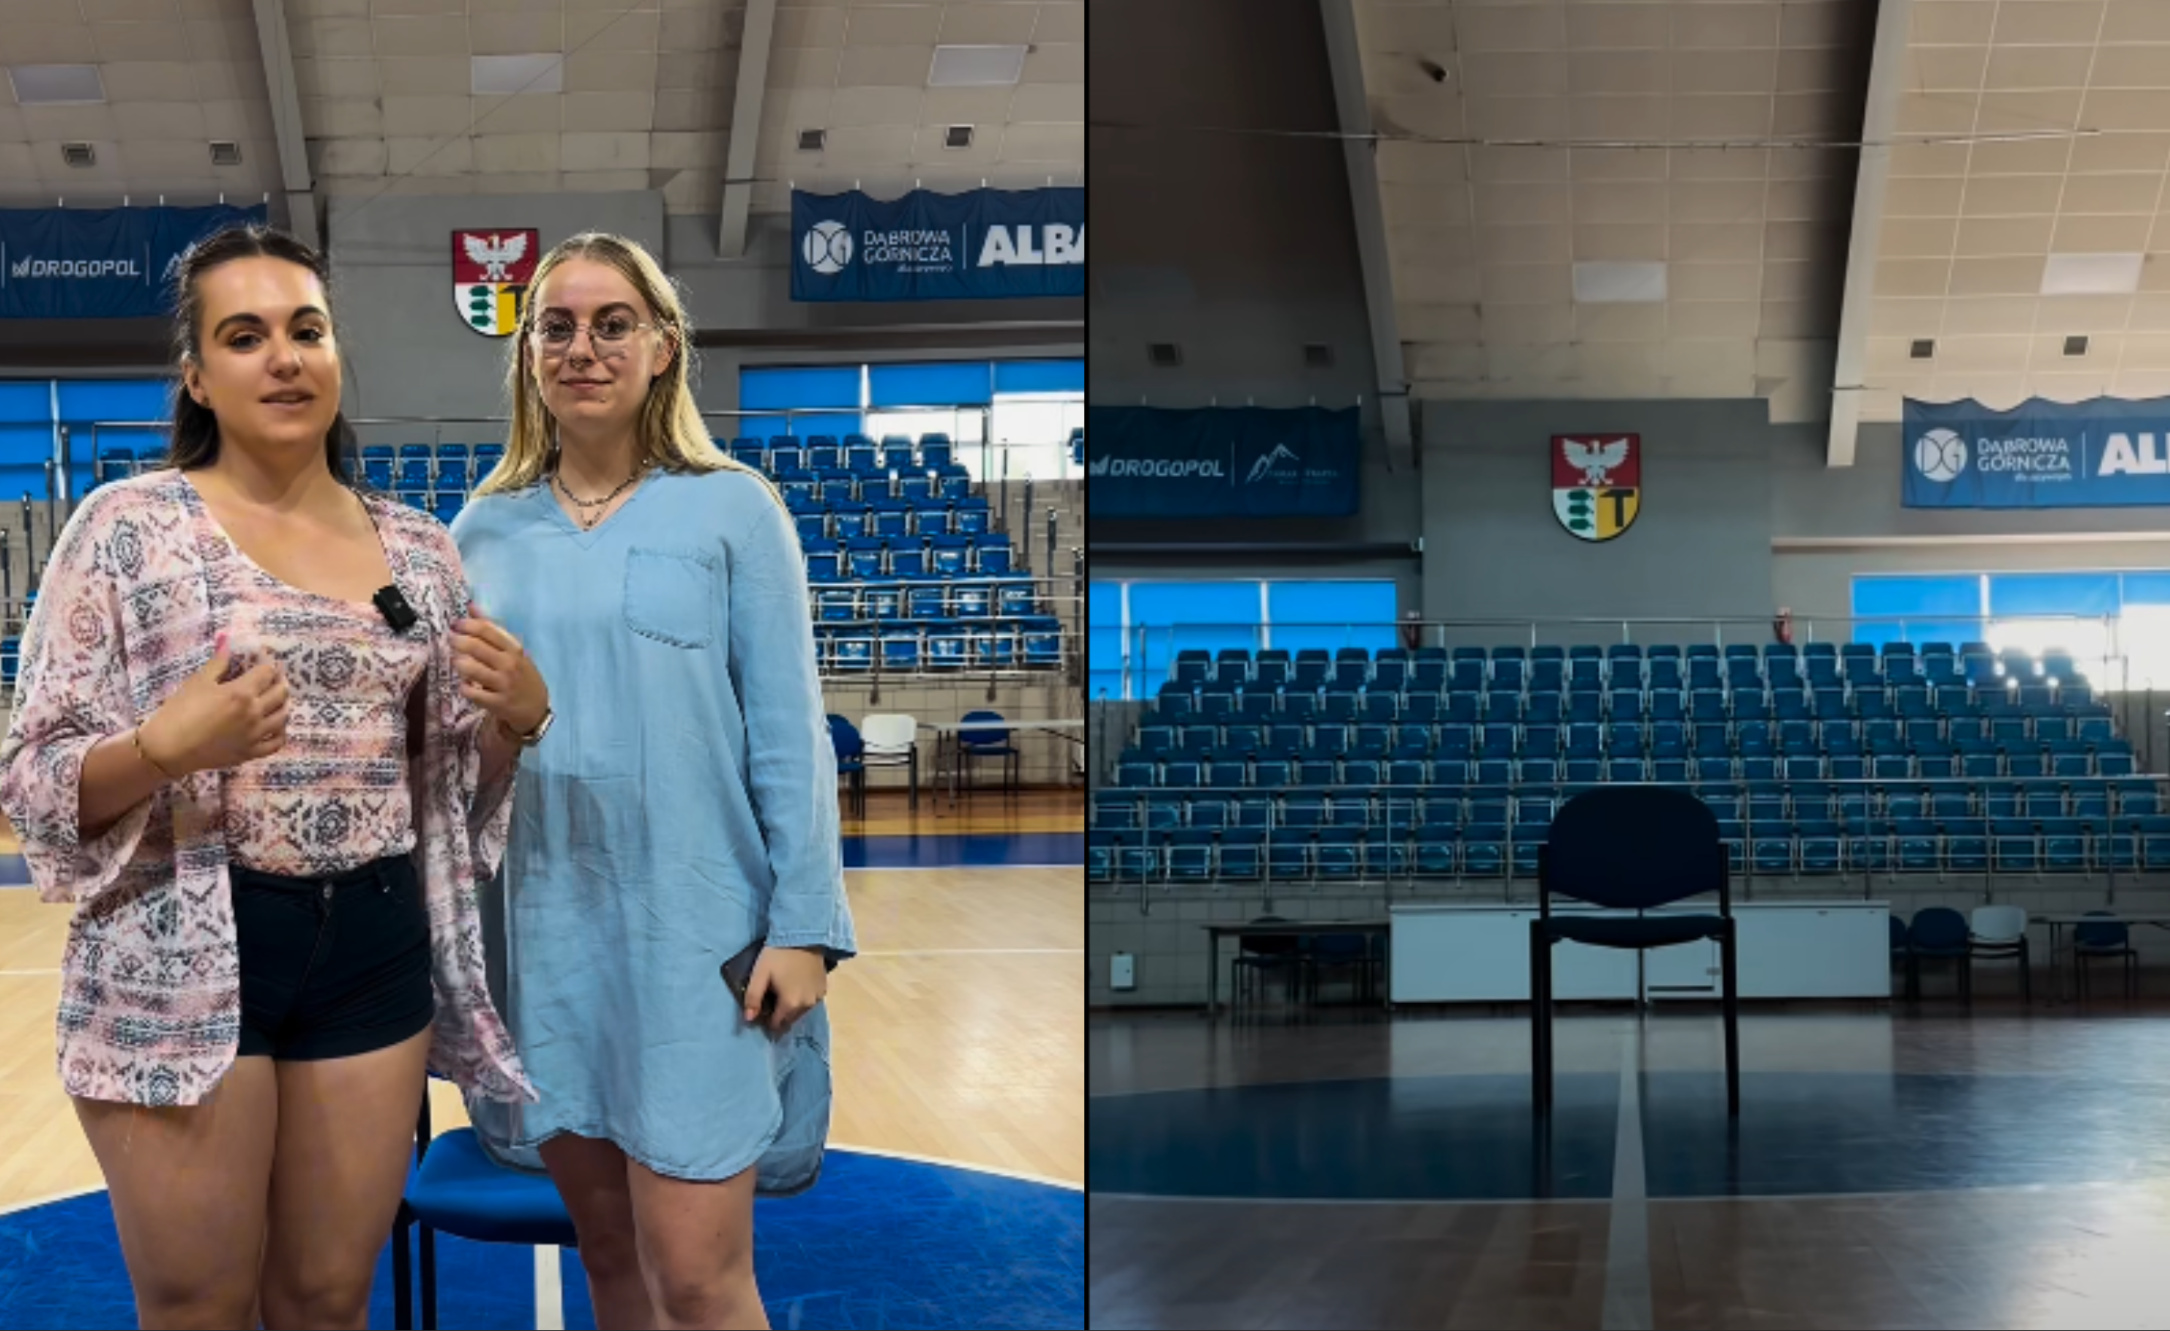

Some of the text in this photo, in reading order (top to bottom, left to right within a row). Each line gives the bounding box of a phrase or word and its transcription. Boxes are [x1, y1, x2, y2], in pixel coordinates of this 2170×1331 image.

[32, 259, 142, 278] DROGOPOL
[2097, 432, 2170, 477] AL
[1110, 459, 1224, 477] DROGOPOL
